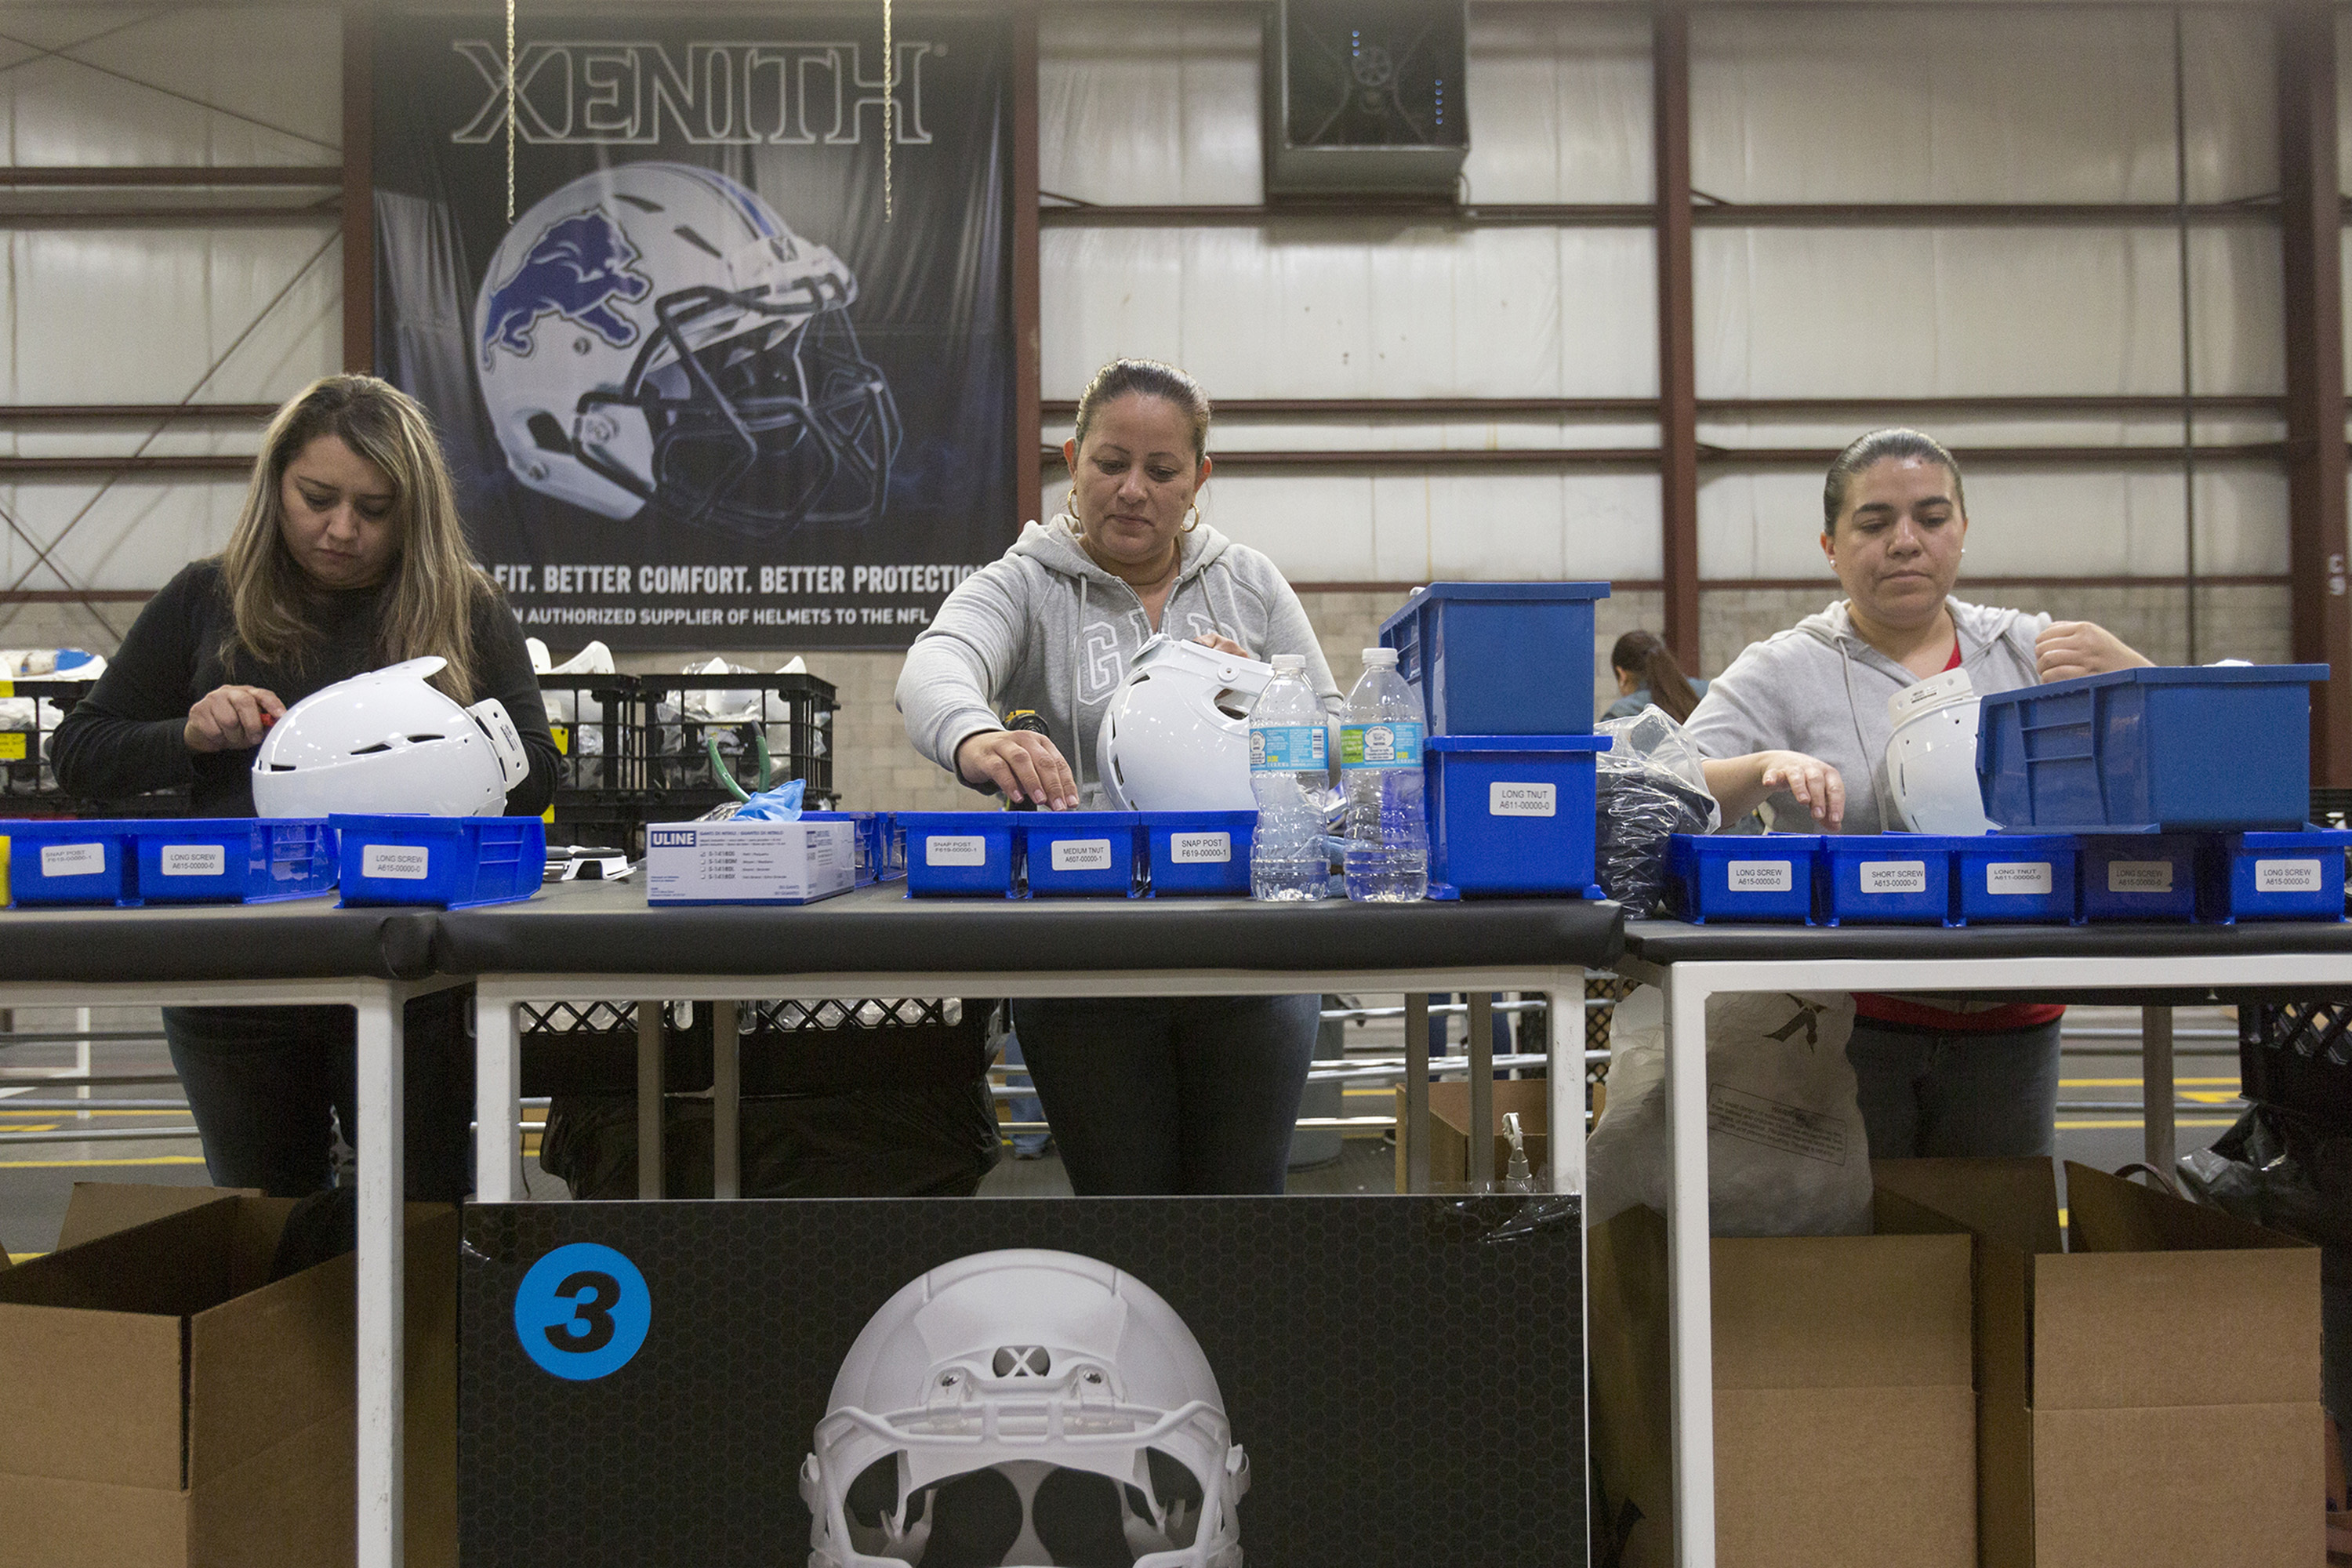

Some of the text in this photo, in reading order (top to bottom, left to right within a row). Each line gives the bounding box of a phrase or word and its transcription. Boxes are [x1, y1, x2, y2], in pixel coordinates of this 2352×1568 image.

[452, 42, 932, 144] XENITH
[494, 564, 985, 594] FIT. BETTER COMFORT. BETTER PROTECTI
[528, 608, 637, 625] AUTHORIZED
[639, 608, 723, 626] SUPPLIER
[727, 608, 750, 625] OF
[753, 608, 832, 626] HELMETS
[834, 608, 856, 625] TO
[860, 608, 895, 625] THE
[1501, 789, 1548, 799] LONG TNUT
[1499, 800, 1550, 810] A611-00000-0
[652, 832, 695, 846] ULINE
[377, 864, 422, 873] A615-00000-0
[544, 1270, 621, 1354] 3
